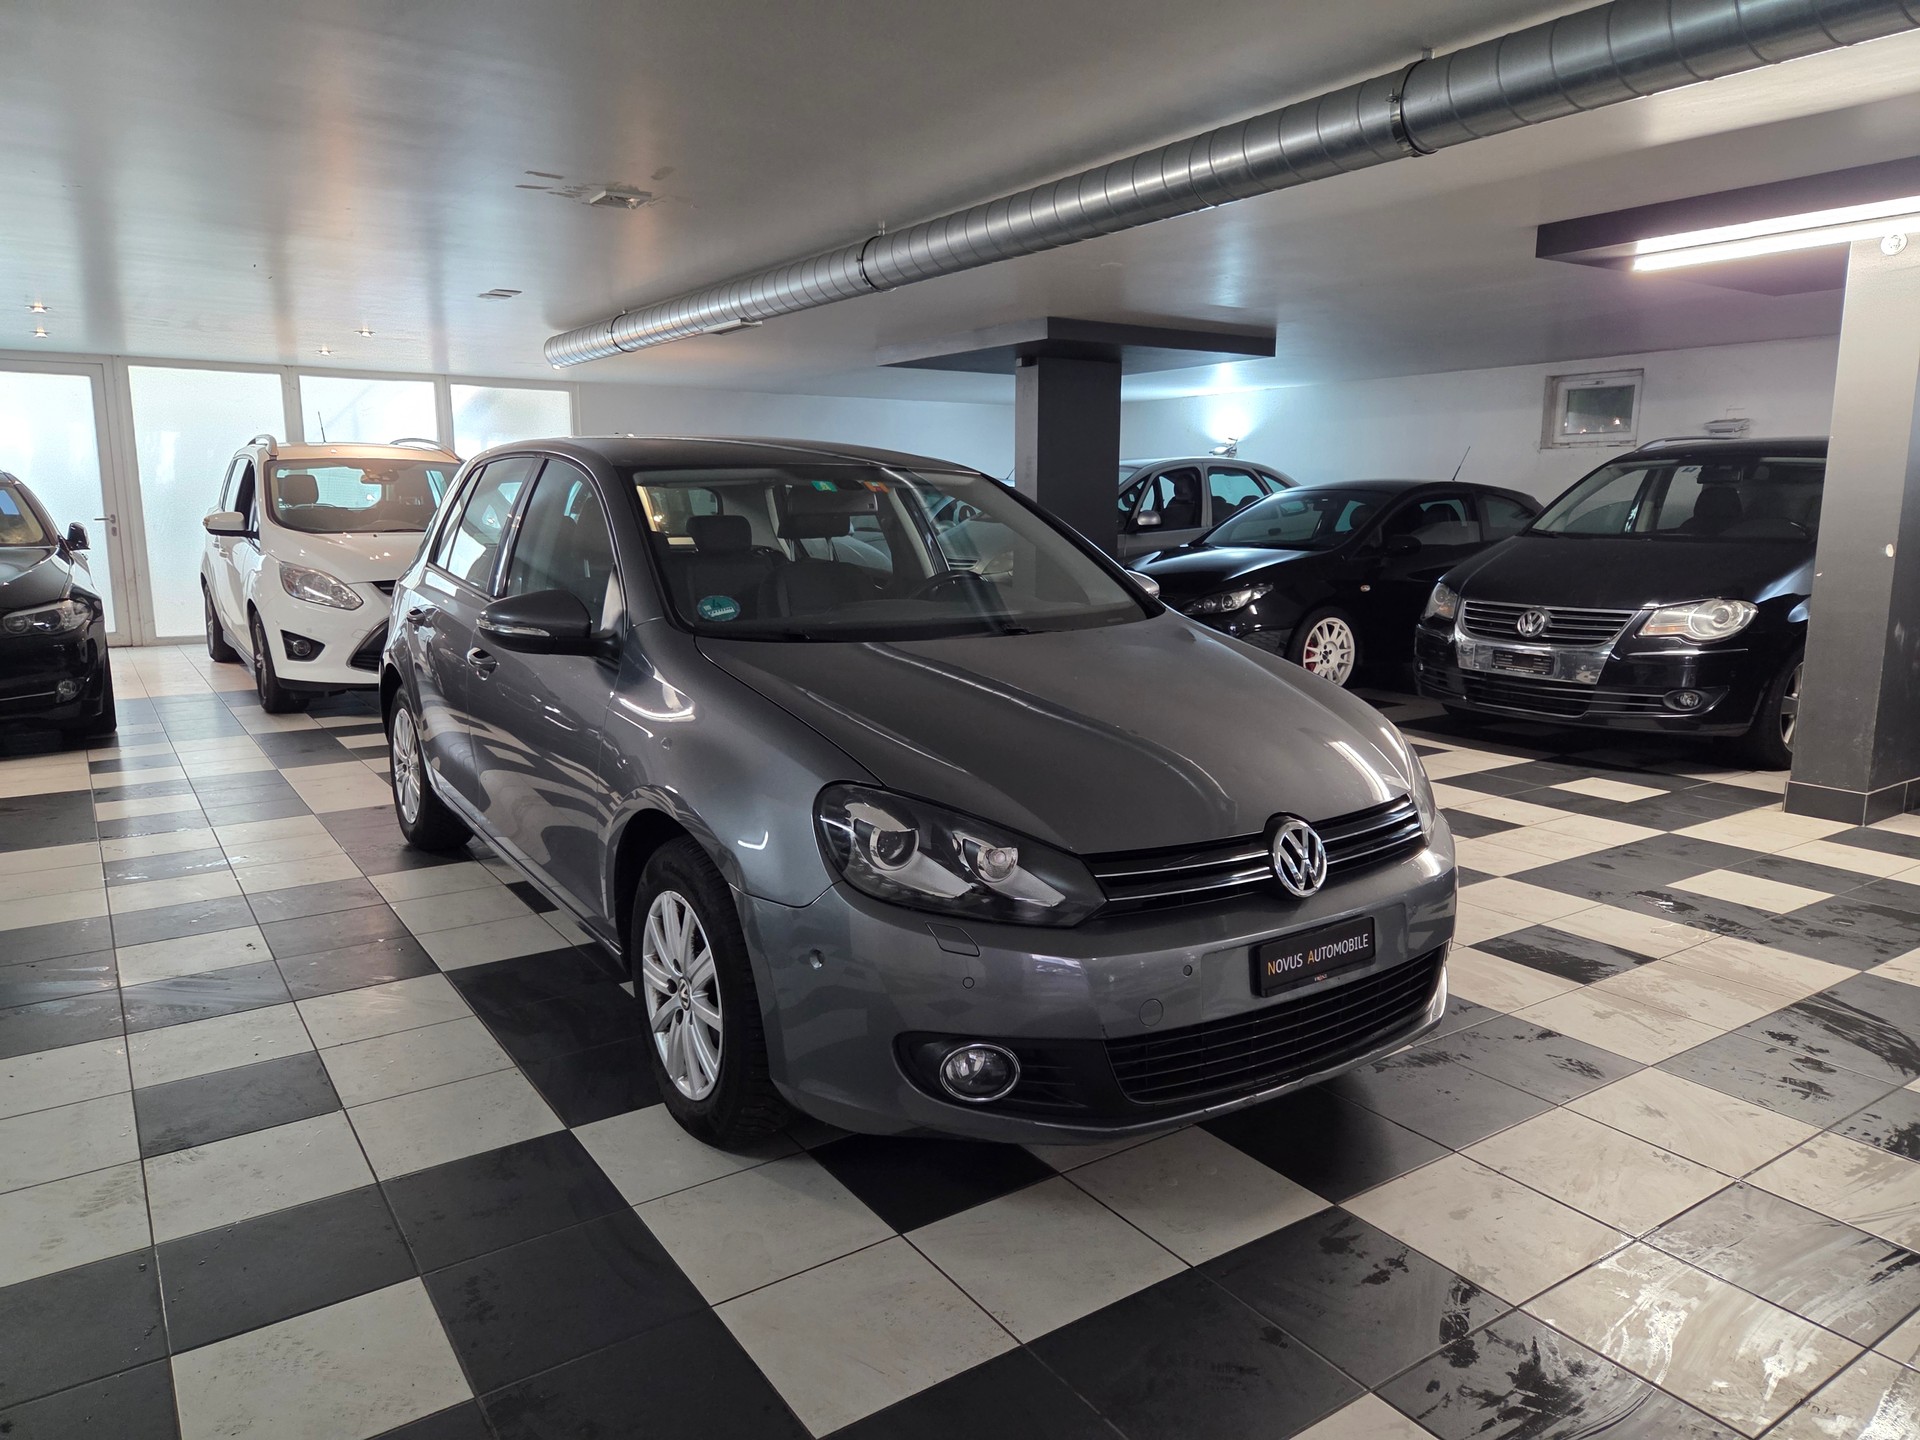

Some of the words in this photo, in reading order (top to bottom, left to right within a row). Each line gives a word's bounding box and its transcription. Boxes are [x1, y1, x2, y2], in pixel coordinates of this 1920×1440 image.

[1273, 820, 1327, 898] VW
[1267, 953, 1303, 976] NOVUS
[1307, 933, 1369, 965] AUTOMOBILE
